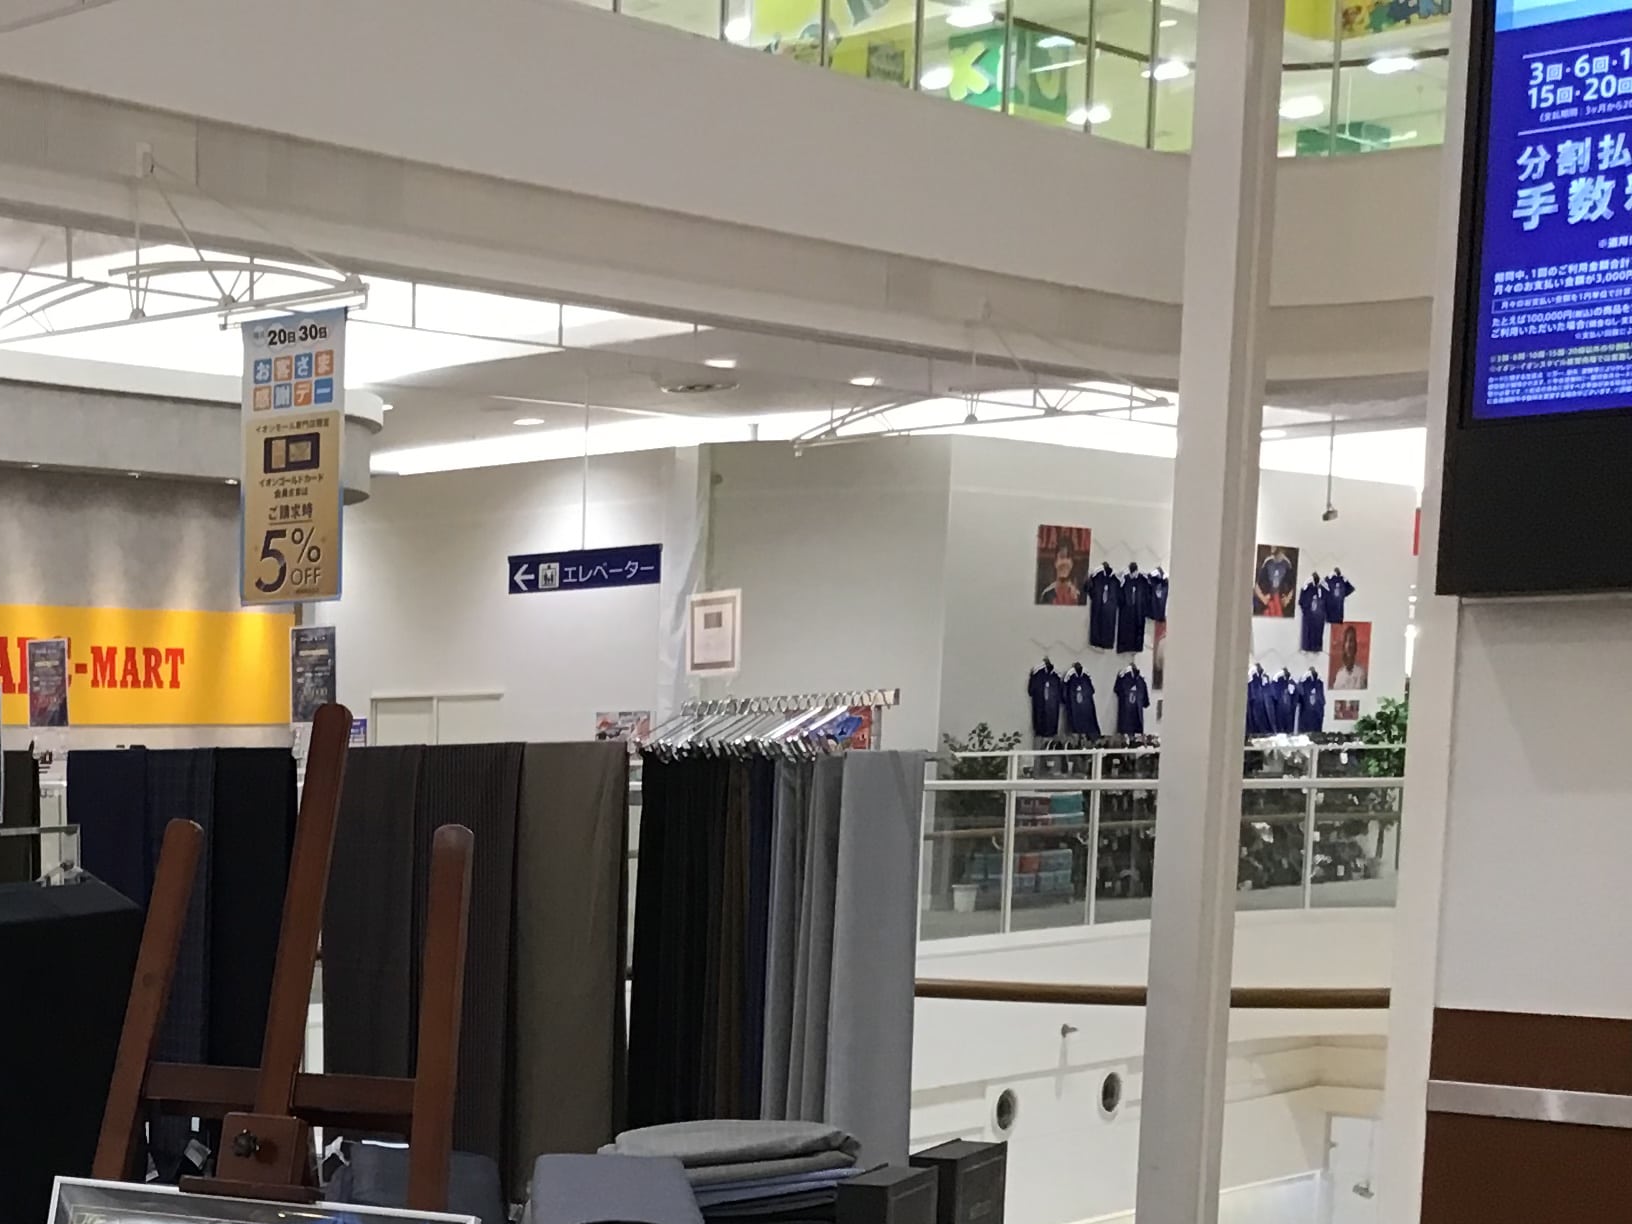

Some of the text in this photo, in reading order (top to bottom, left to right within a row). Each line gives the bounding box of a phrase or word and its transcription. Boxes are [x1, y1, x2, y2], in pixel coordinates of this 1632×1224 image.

[1529, 47, 1632, 86] 3回・6回・1
[1512, 172, 1632, 231] 手数
[268, 328, 296, 346] 20日
[299, 324, 327, 342] 30日
[290, 568, 321, 586] OFF
[563, 560, 655, 583] エレベーター
